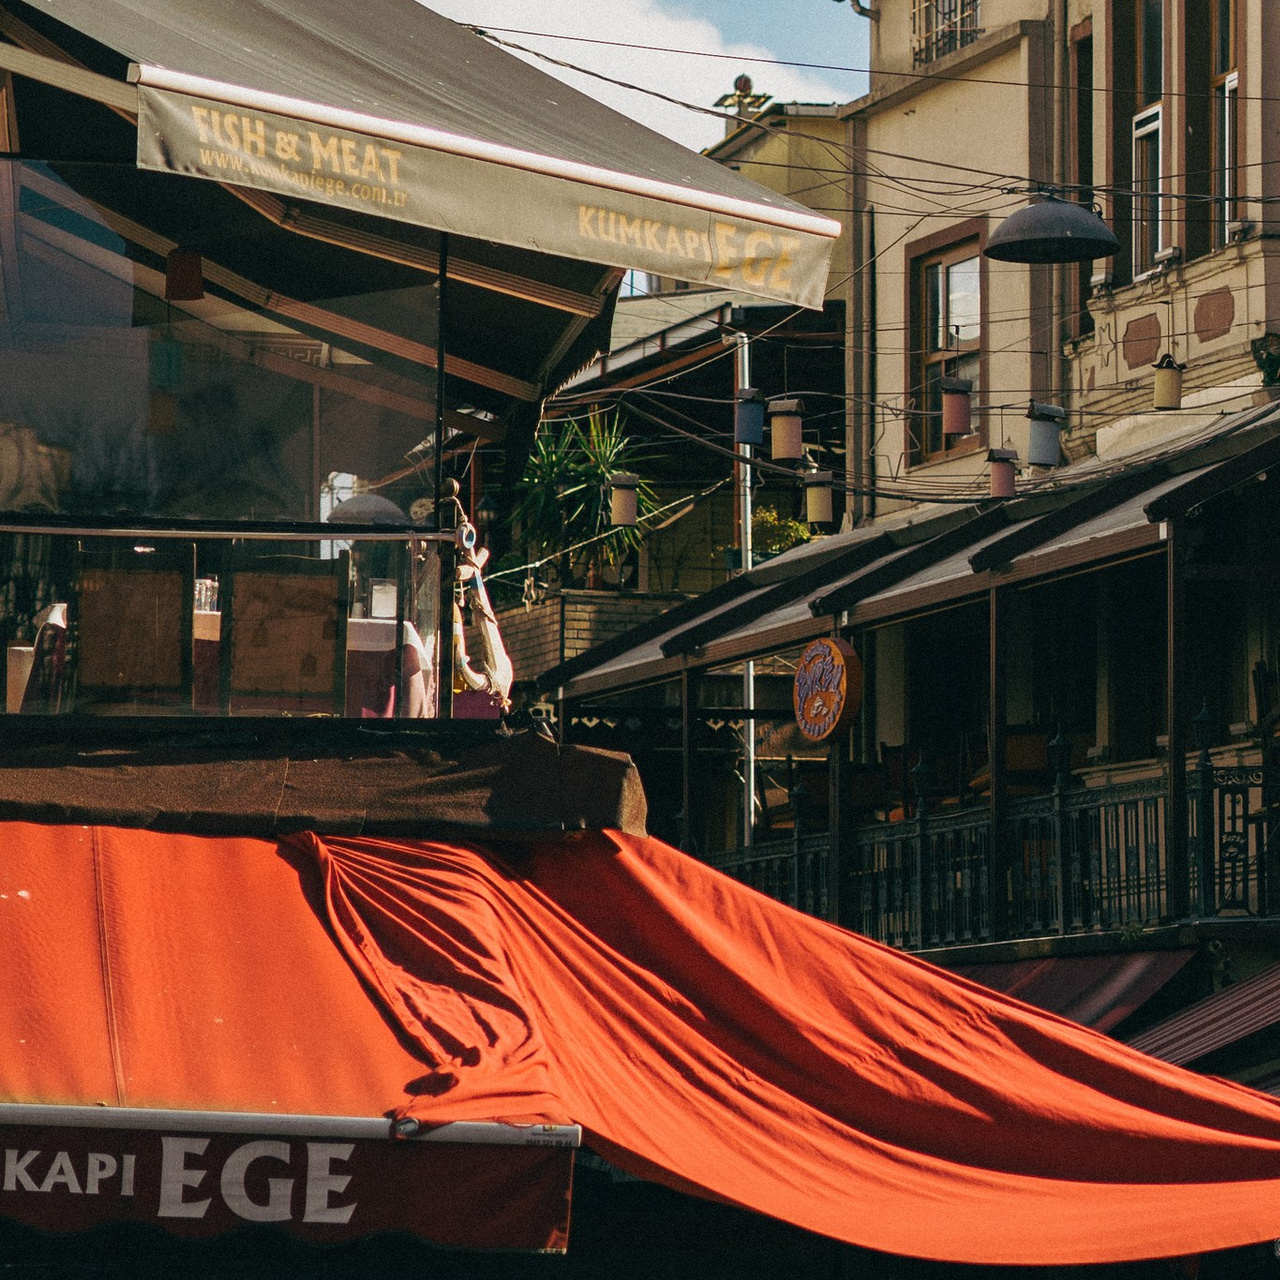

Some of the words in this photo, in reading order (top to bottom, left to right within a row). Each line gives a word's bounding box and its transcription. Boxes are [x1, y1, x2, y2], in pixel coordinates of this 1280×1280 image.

[191, 105, 266, 158] FISH
[275, 131, 301, 161] &
[308, 131, 402, 185] MEAT
[578, 205, 712, 262] KUMKAPI
[714, 222, 801, 291] EGE
[2, 1149, 135, 1197] KAPI
[157, 1136, 358, 1224] EGE
